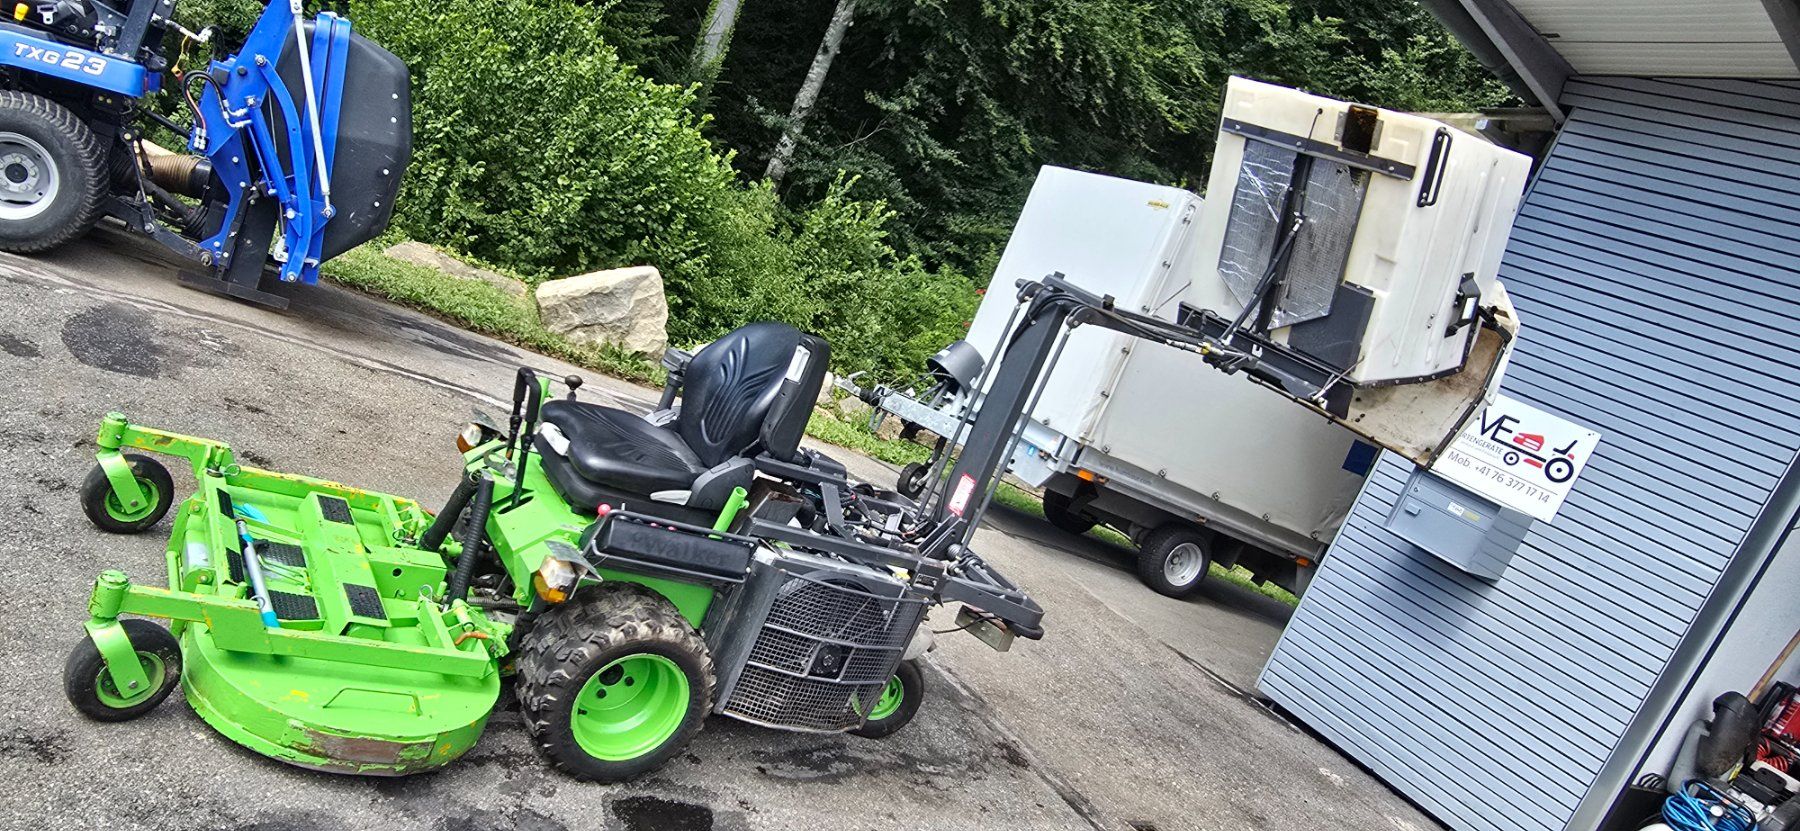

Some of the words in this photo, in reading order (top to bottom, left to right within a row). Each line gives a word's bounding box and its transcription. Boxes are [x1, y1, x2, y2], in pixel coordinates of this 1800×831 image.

[14, 42, 60, 65] TXG
[60, 50, 107, 76] 23
[1448, 451, 1471, 469] Mob.
[1475, 465, 1491, 477] +41
[1491, 471, 1504, 483] 76
[1505, 478, 1526, 492] 377
[1527, 486, 1537, 497] 17
[1539, 491, 1551, 503] 14
